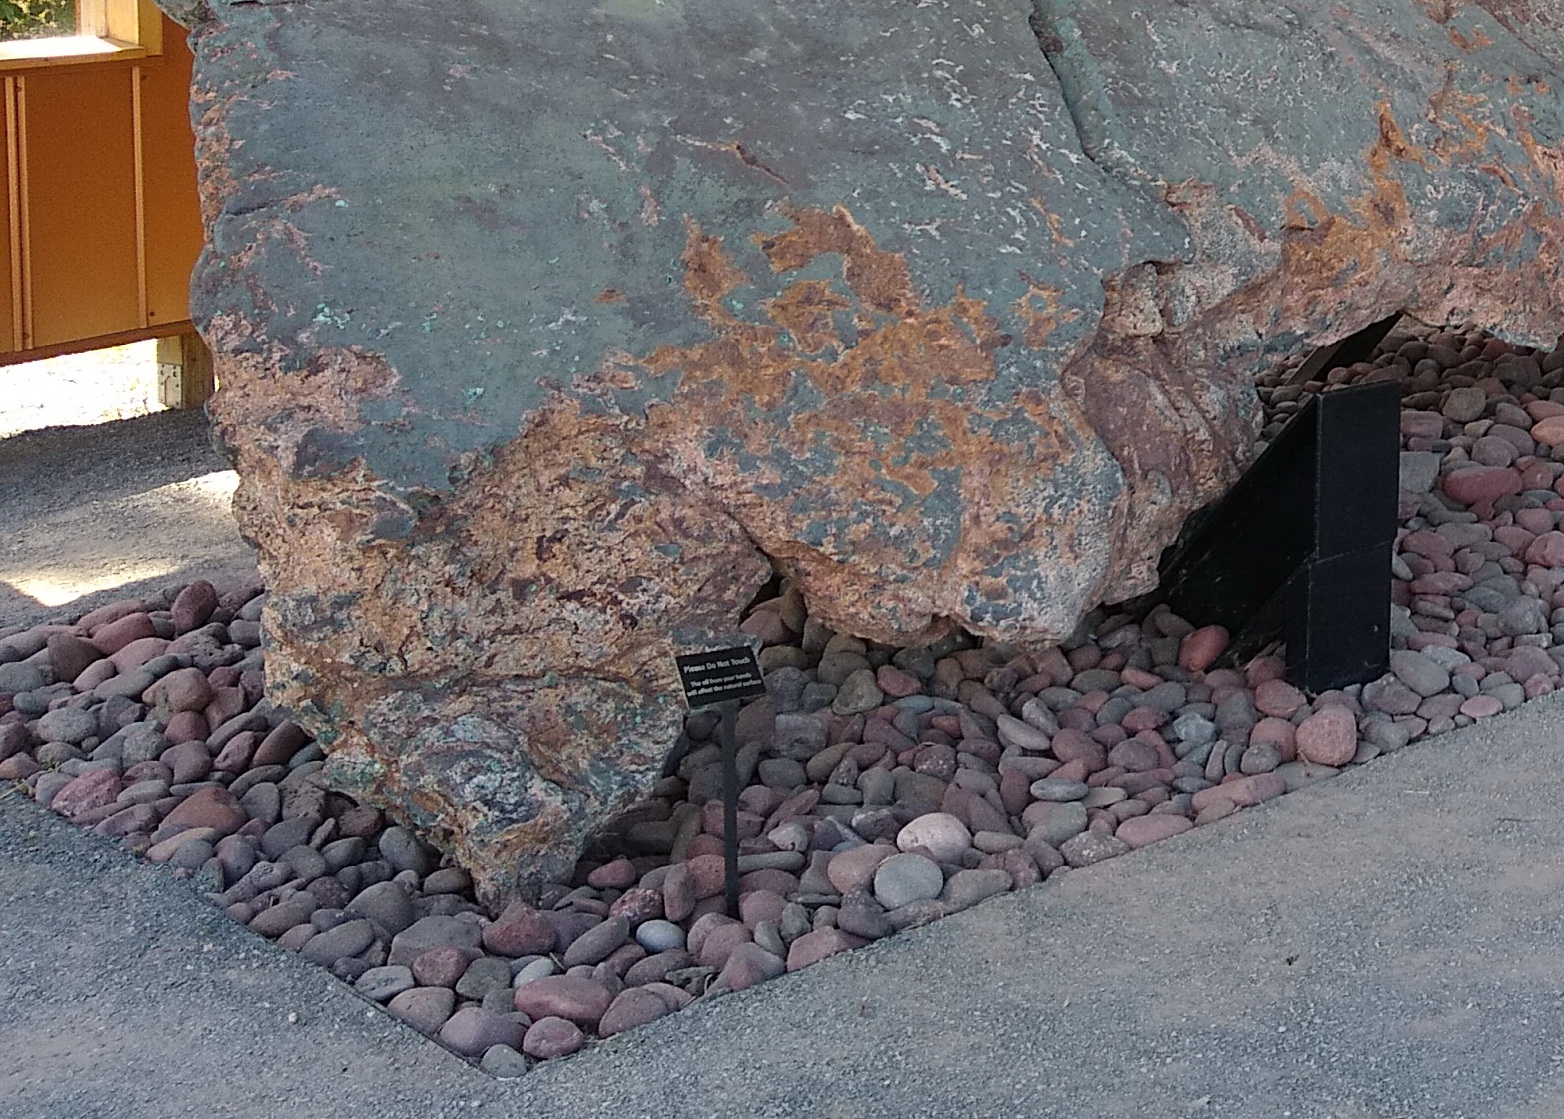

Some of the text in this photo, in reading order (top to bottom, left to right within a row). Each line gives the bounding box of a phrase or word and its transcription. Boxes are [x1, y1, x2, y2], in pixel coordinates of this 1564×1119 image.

[683, 657, 750, 673] Please Do Not Touch
[723, 682, 742, 690] natural
